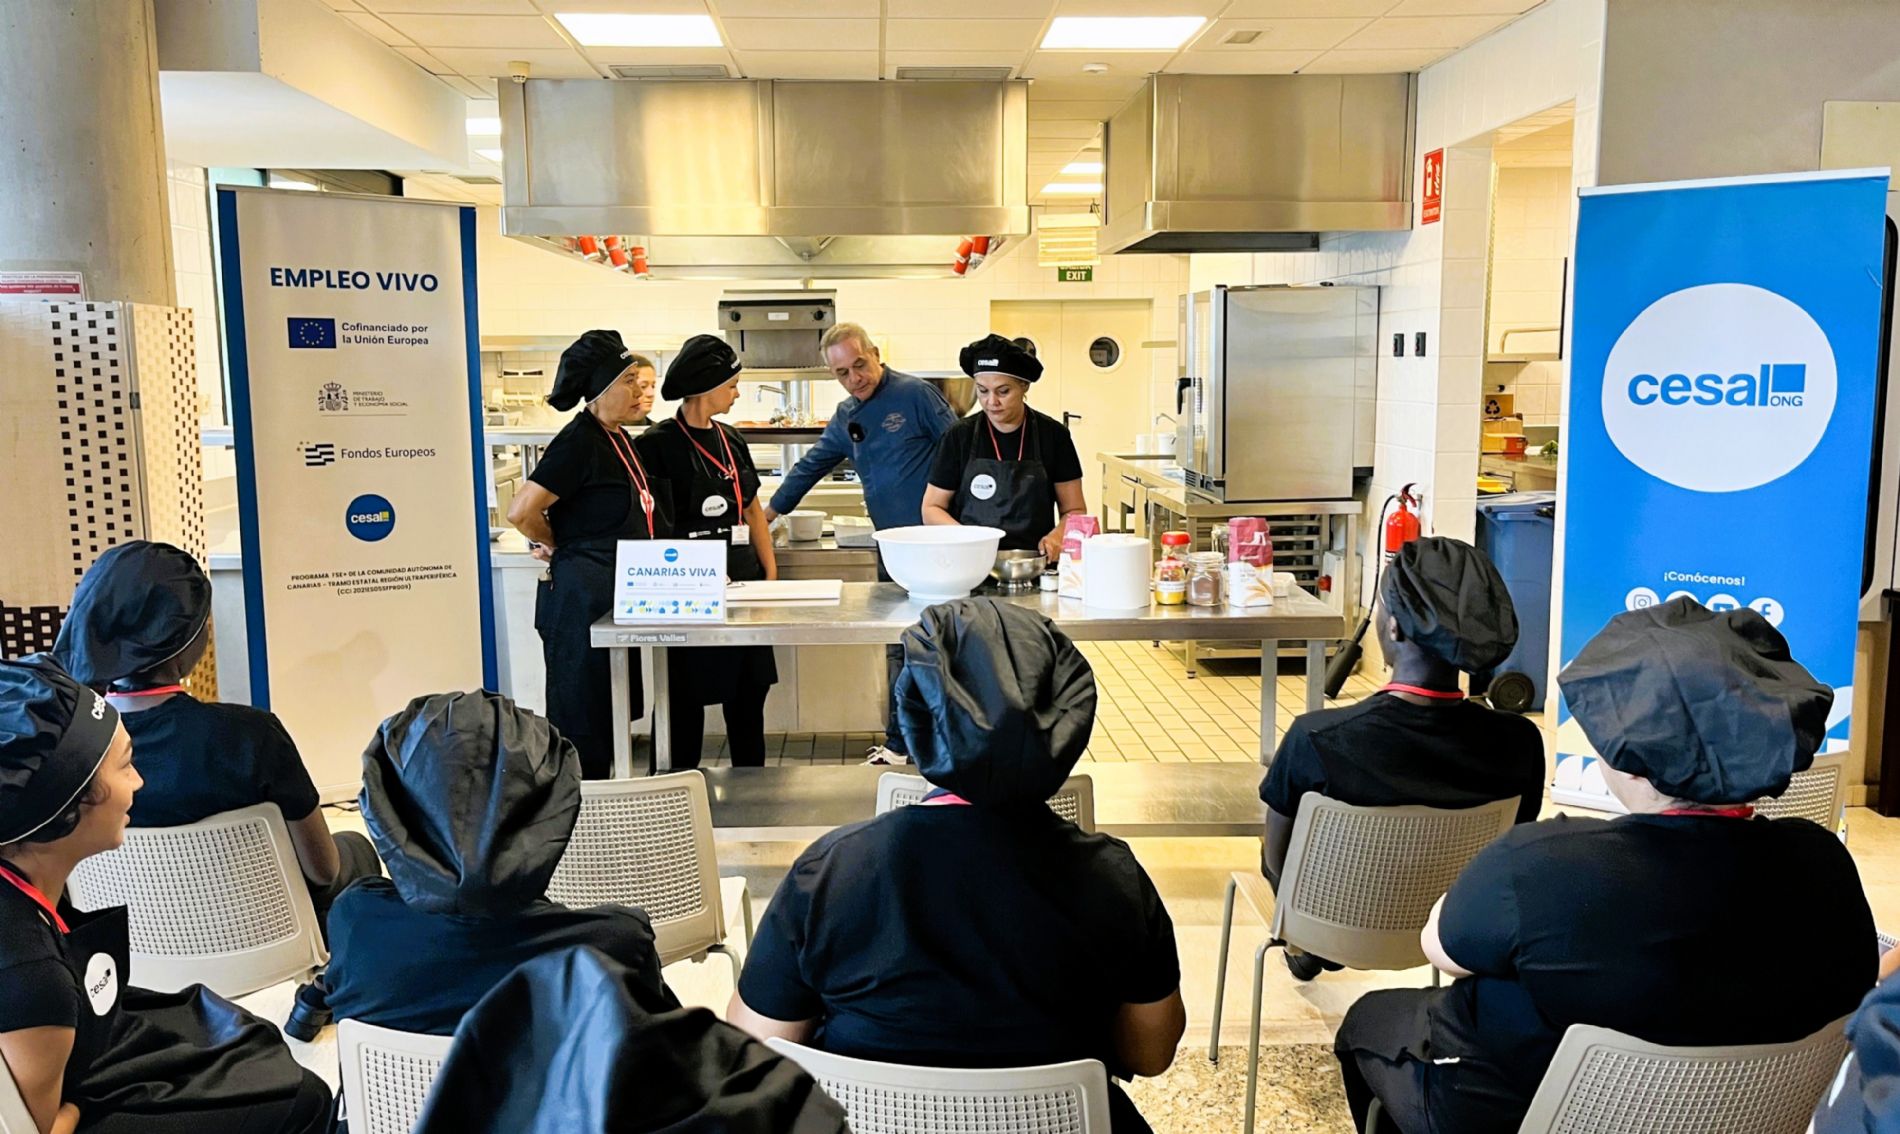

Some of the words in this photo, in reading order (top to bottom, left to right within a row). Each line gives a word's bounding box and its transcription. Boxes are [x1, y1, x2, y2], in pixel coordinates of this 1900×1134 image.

[270, 267, 370, 289] EMPLEO
[376, 272, 438, 292] VIVO
[1066, 271, 1087, 281] EXIT
[342, 322, 408, 332] Cofinanciado
[411, 325, 428, 333] por
[342, 335, 351, 344] la
[354, 334, 385, 345] Unión
[387, 335, 429, 346] Europea
[1628, 364, 1771, 406] cesal
[1770, 395, 1803, 407] ONG
[341, 447, 382, 459] Fondos
[385, 447, 436, 459] Europeos
[350, 511, 382, 523] cesal
[291, 572, 329, 581] PROGRAMA
[366, 567, 406, 575] COMUNIDAD
[627, 567, 686, 577] CANARIAS
[689, 568, 717, 577] VIVA
[287, 582, 321, 590] CANARIAS
[352, 578, 379, 586] ESTATAL
[380, 575, 404, 583] REGIÓN
[1664, 571, 1745, 586] ¡Conócenos!
[630, 633, 657, 643] Flores
[659, 633, 686, 643] Valles
